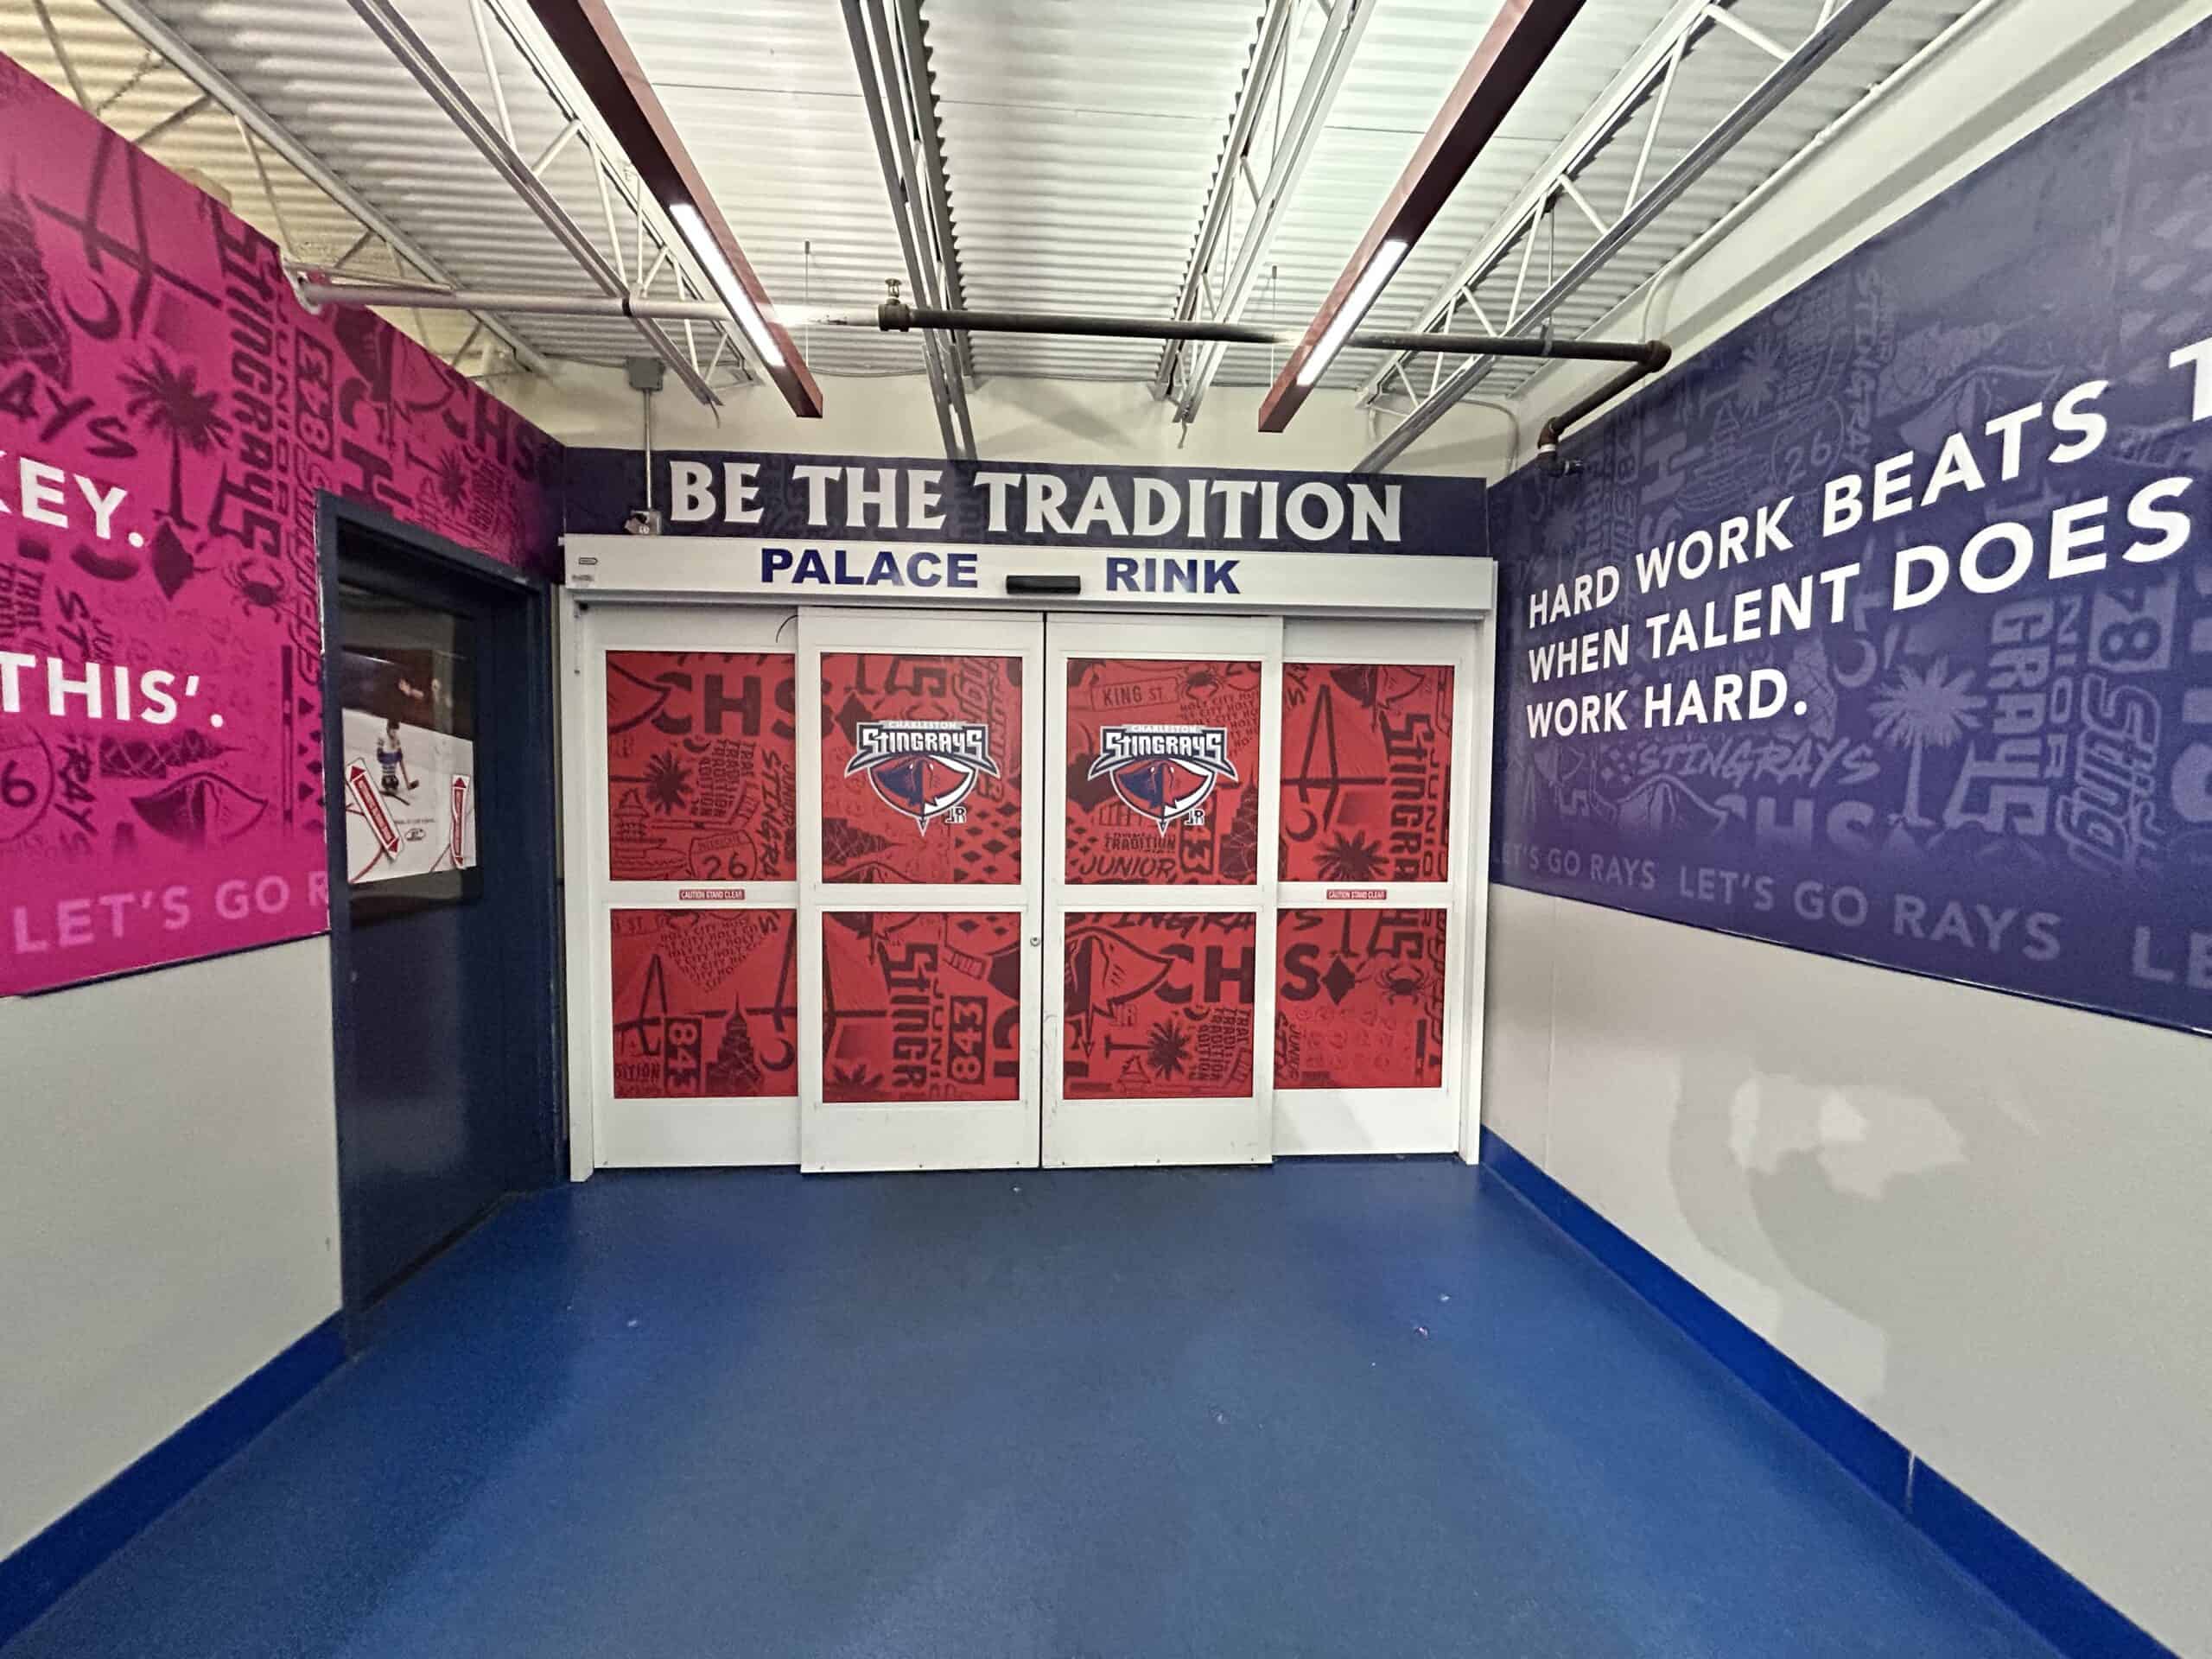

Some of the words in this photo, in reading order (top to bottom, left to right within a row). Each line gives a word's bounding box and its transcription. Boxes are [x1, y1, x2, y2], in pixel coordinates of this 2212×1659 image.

[0, 449, 144, 548] EY.
[670, 461, 765, 524] BE
[792, 464, 946, 530] THE
[973, 471, 1402, 543] TRADITION
[1529, 565, 1620, 628] HARD
[1637, 496, 1796, 594] WORK
[1823, 380, 2109, 537] BEATS
[761, 548, 978, 588] PALACE
[1106, 557, 1241, 594] RINK
[1529, 624, 1629, 684] WHEN
[1646, 563, 1860, 659] TALENT
[1893, 477, 2194, 610] DOES
[1103, 685, 1142, 707] KING
[1147, 687, 1164, 702] ST
[1527, 690, 1628, 739] WORK
[1644, 668, 1808, 728] HARD.
[863, 728, 983, 760] STINGRAYS
[1105, 731, 1223, 759] STINGRAYS
[1638, 736, 1881, 787] STINGRAYS
[681, 891, 705, 899] CAUTION
[706, 891, 724, 899] STAND
[724, 891, 743, 899] CLEAR
[1078, 855, 1176, 878] JUNIOR
[1328, 891, 1350, 899] CAUTION
[14, 887, 189, 953] LET'S
[215, 875, 289, 920] GO
[1548, 847, 1581, 877] GO
[1590, 852, 1656, 890] RAYS
[1680, 867, 1775, 912] LET'S
[1793, 880, 1868, 928] GO
[1893, 893, 2063, 962] RAYS
[950, 1000, 983, 1082] 843
